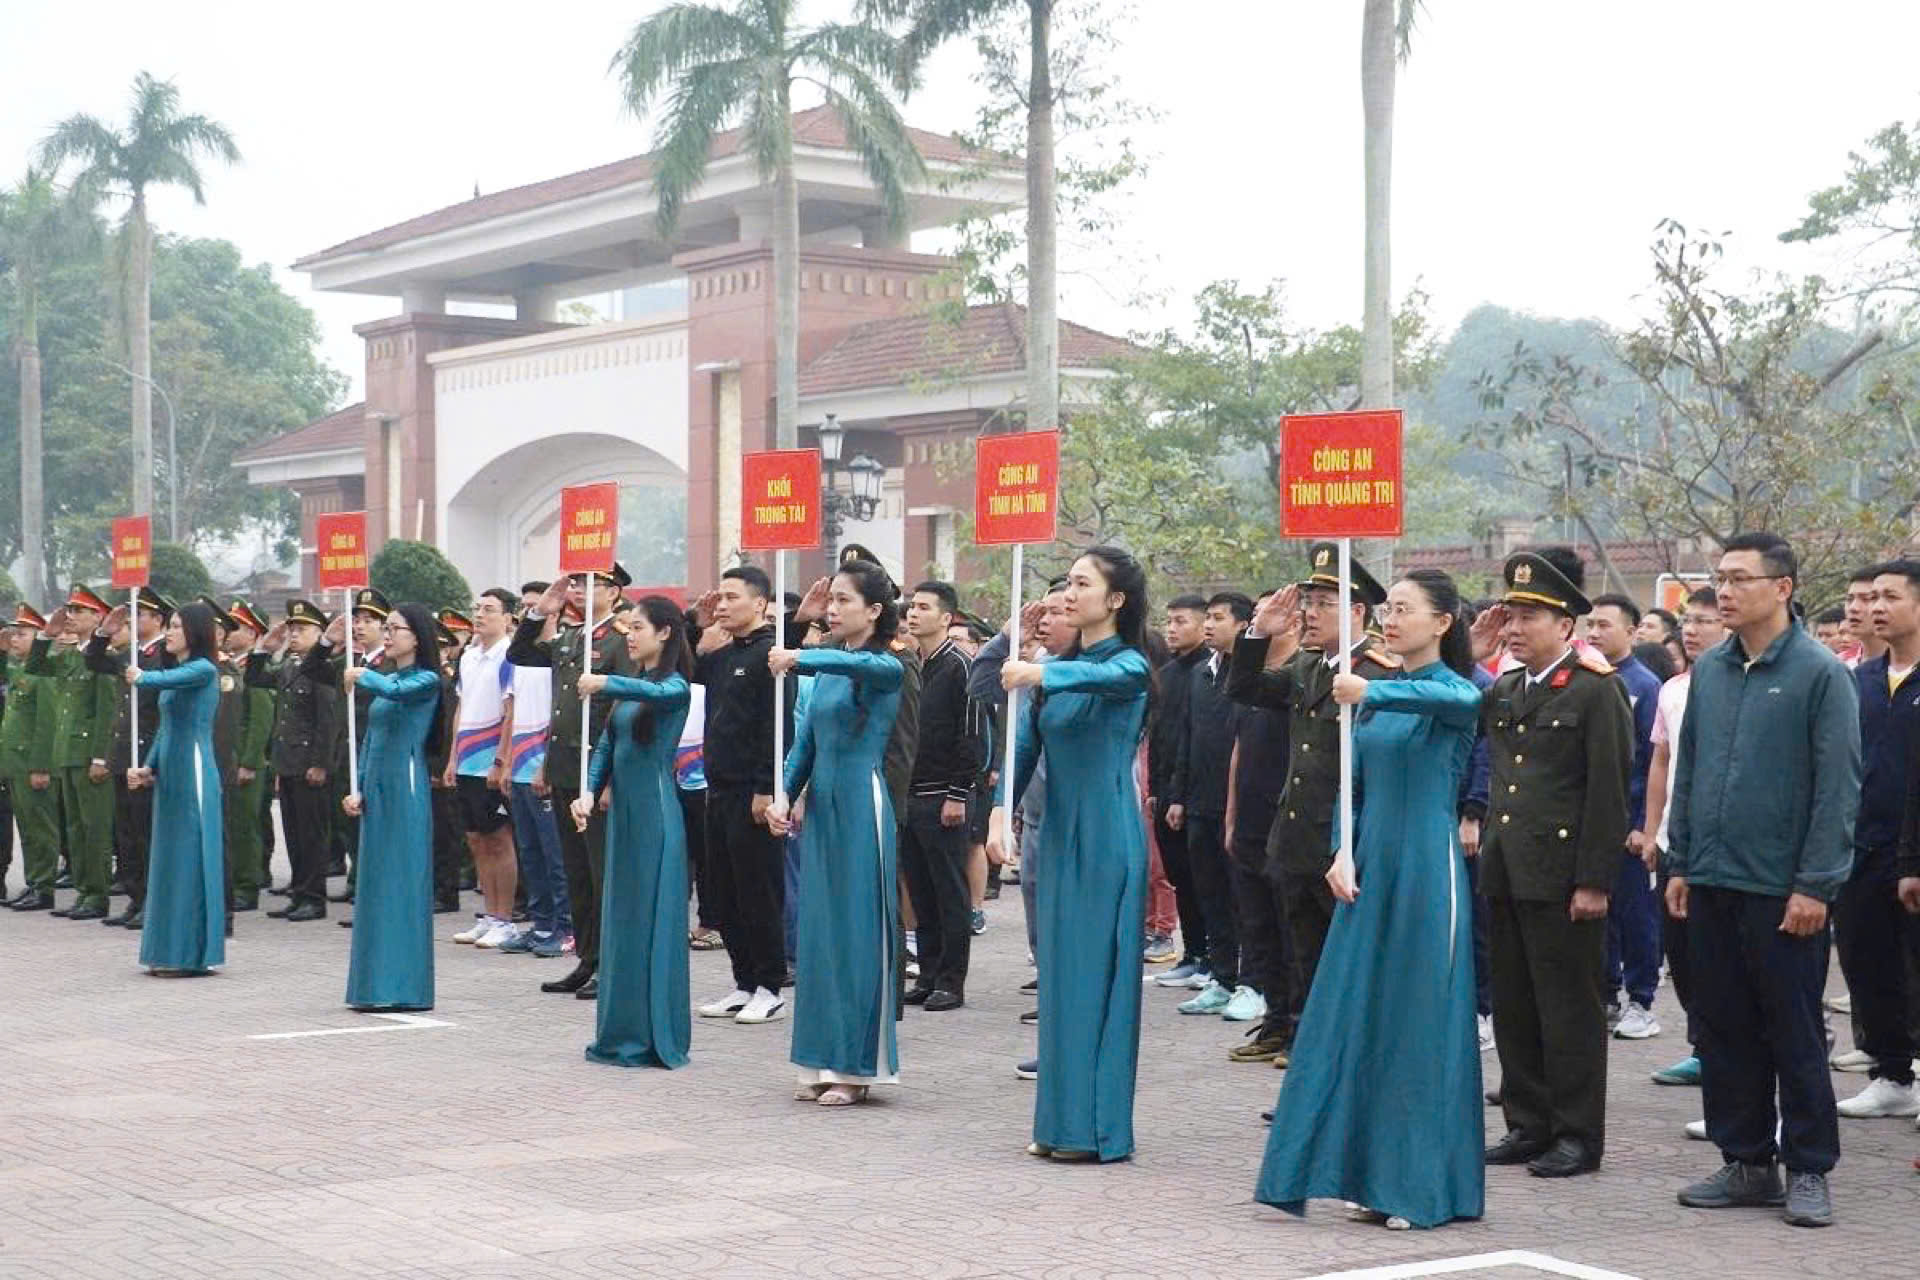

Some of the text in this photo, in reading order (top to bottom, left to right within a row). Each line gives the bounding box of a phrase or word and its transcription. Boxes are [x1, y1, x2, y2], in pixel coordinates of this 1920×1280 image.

[1313, 445, 1372, 472] CÔNG AN
[767, 472, 793, 497] KHỐI
[999, 462, 1038, 486] CÔNG AN
[1290, 475, 1395, 508] TỈNH QUẢNG TRỊ
[755, 502, 806, 528] TRỌNG TÀI
